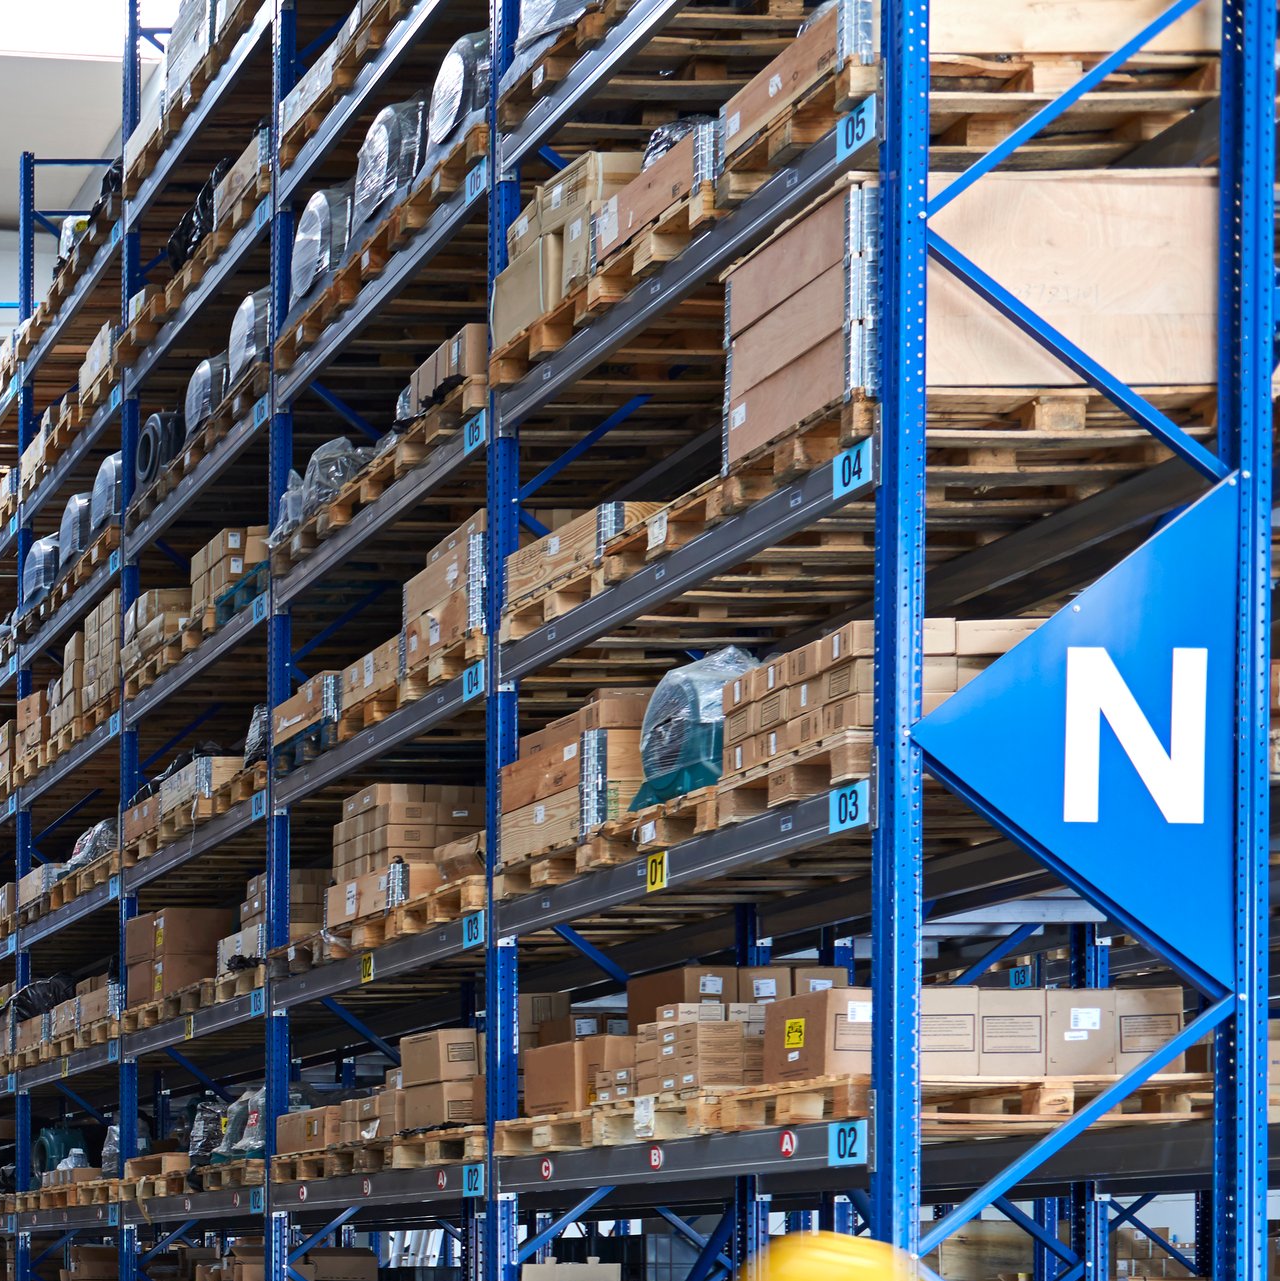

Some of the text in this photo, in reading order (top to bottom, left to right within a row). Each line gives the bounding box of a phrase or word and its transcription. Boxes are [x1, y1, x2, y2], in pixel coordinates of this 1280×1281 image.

[845, 106, 866, 150] 05
[470, 169, 482, 198] 06
[468, 419, 481, 448] 05
[842, 449, 864, 489] 04
[467, 670, 478, 695] 04
[1063, 647, 1209, 825] N
[838, 788, 860, 826] 03
[650, 856, 664, 887] 01
[467, 917, 479, 942] 03
[362, 956, 372, 979] 02
[1014, 969, 1026, 986] 03
[781, 1134, 793, 1152] A
[837, 1126, 858, 1160] 02
[541, 1160, 549, 1177] C
[651, 1149, 660, 1166] B
[467, 1169, 479, 1192] 02
